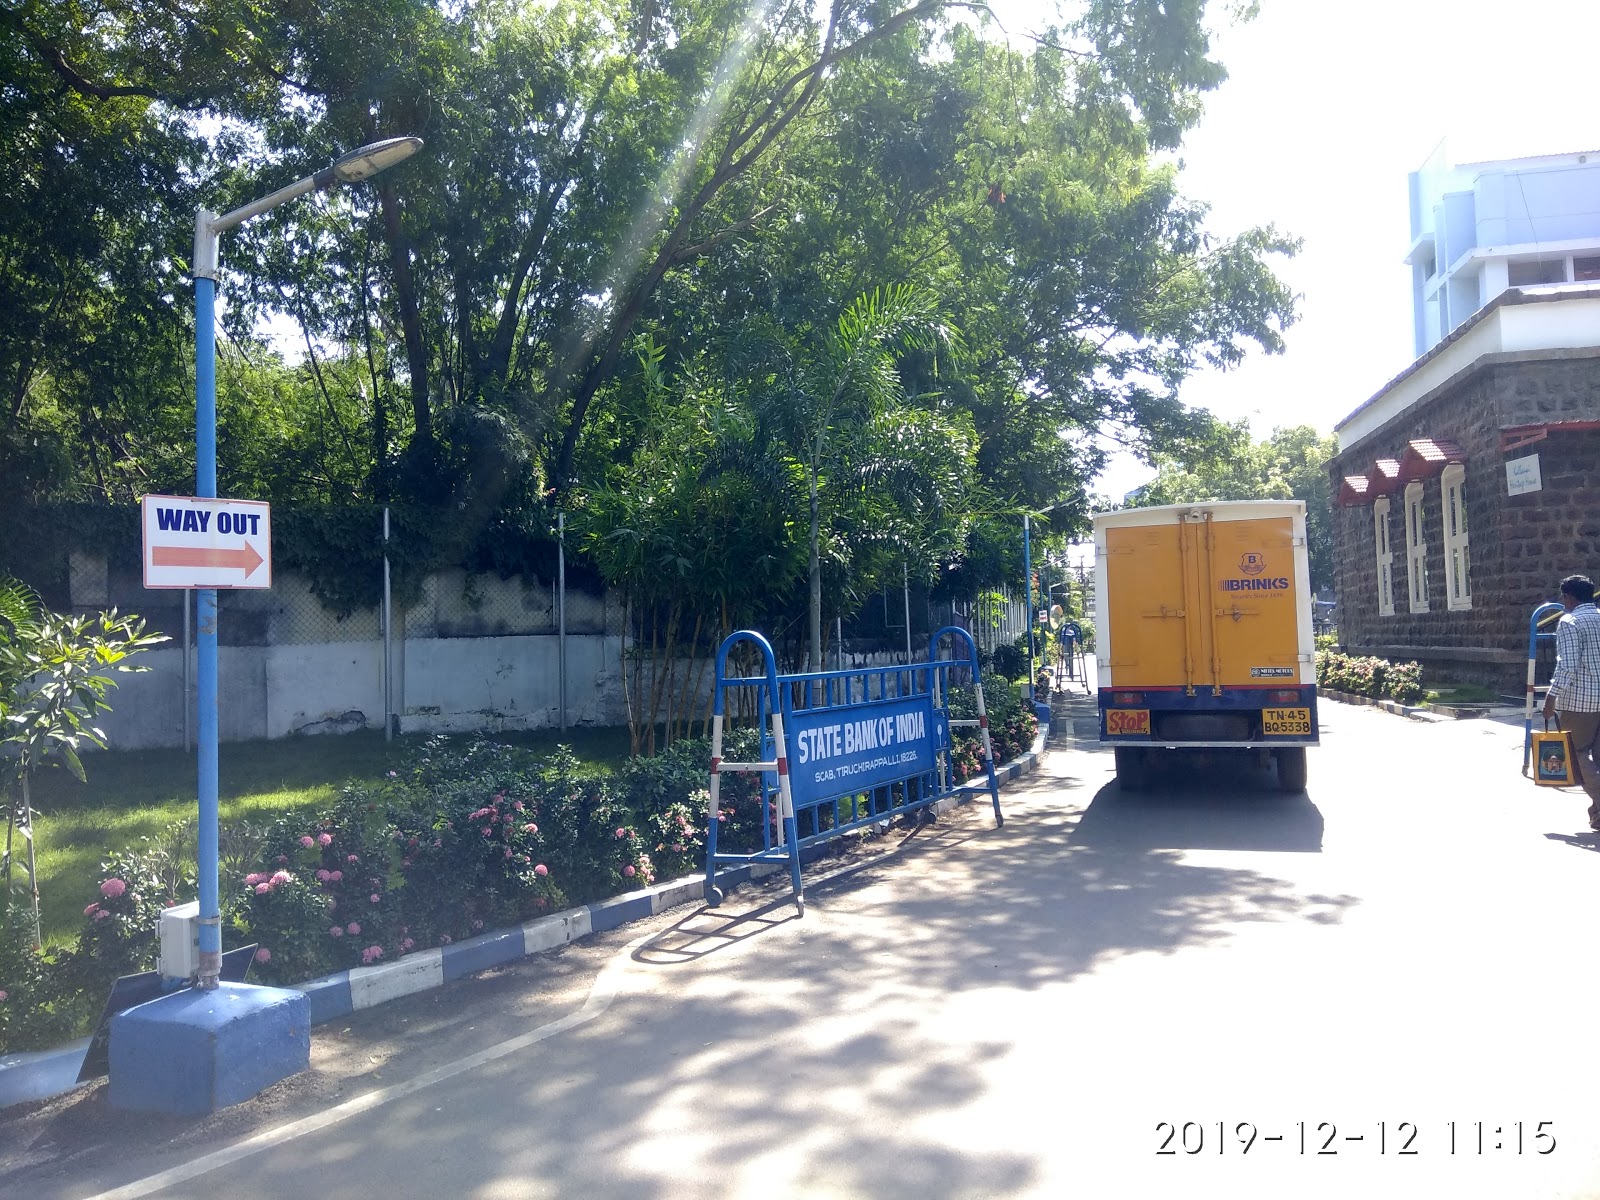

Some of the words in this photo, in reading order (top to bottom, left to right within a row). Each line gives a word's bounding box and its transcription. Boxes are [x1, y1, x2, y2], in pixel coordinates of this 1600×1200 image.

[156, 507, 212, 533] WAY
[217, 511, 261, 536] OUT
[1248, 555, 1257, 564] B
[1230, 577, 1289, 591] BRINKS
[797, 724, 843, 764] STATE
[844, 718, 878, 755] BANK
[878, 716, 895, 747] OF
[896, 711, 926, 744] INDIA
[814, 771, 836, 783] SCAB,
